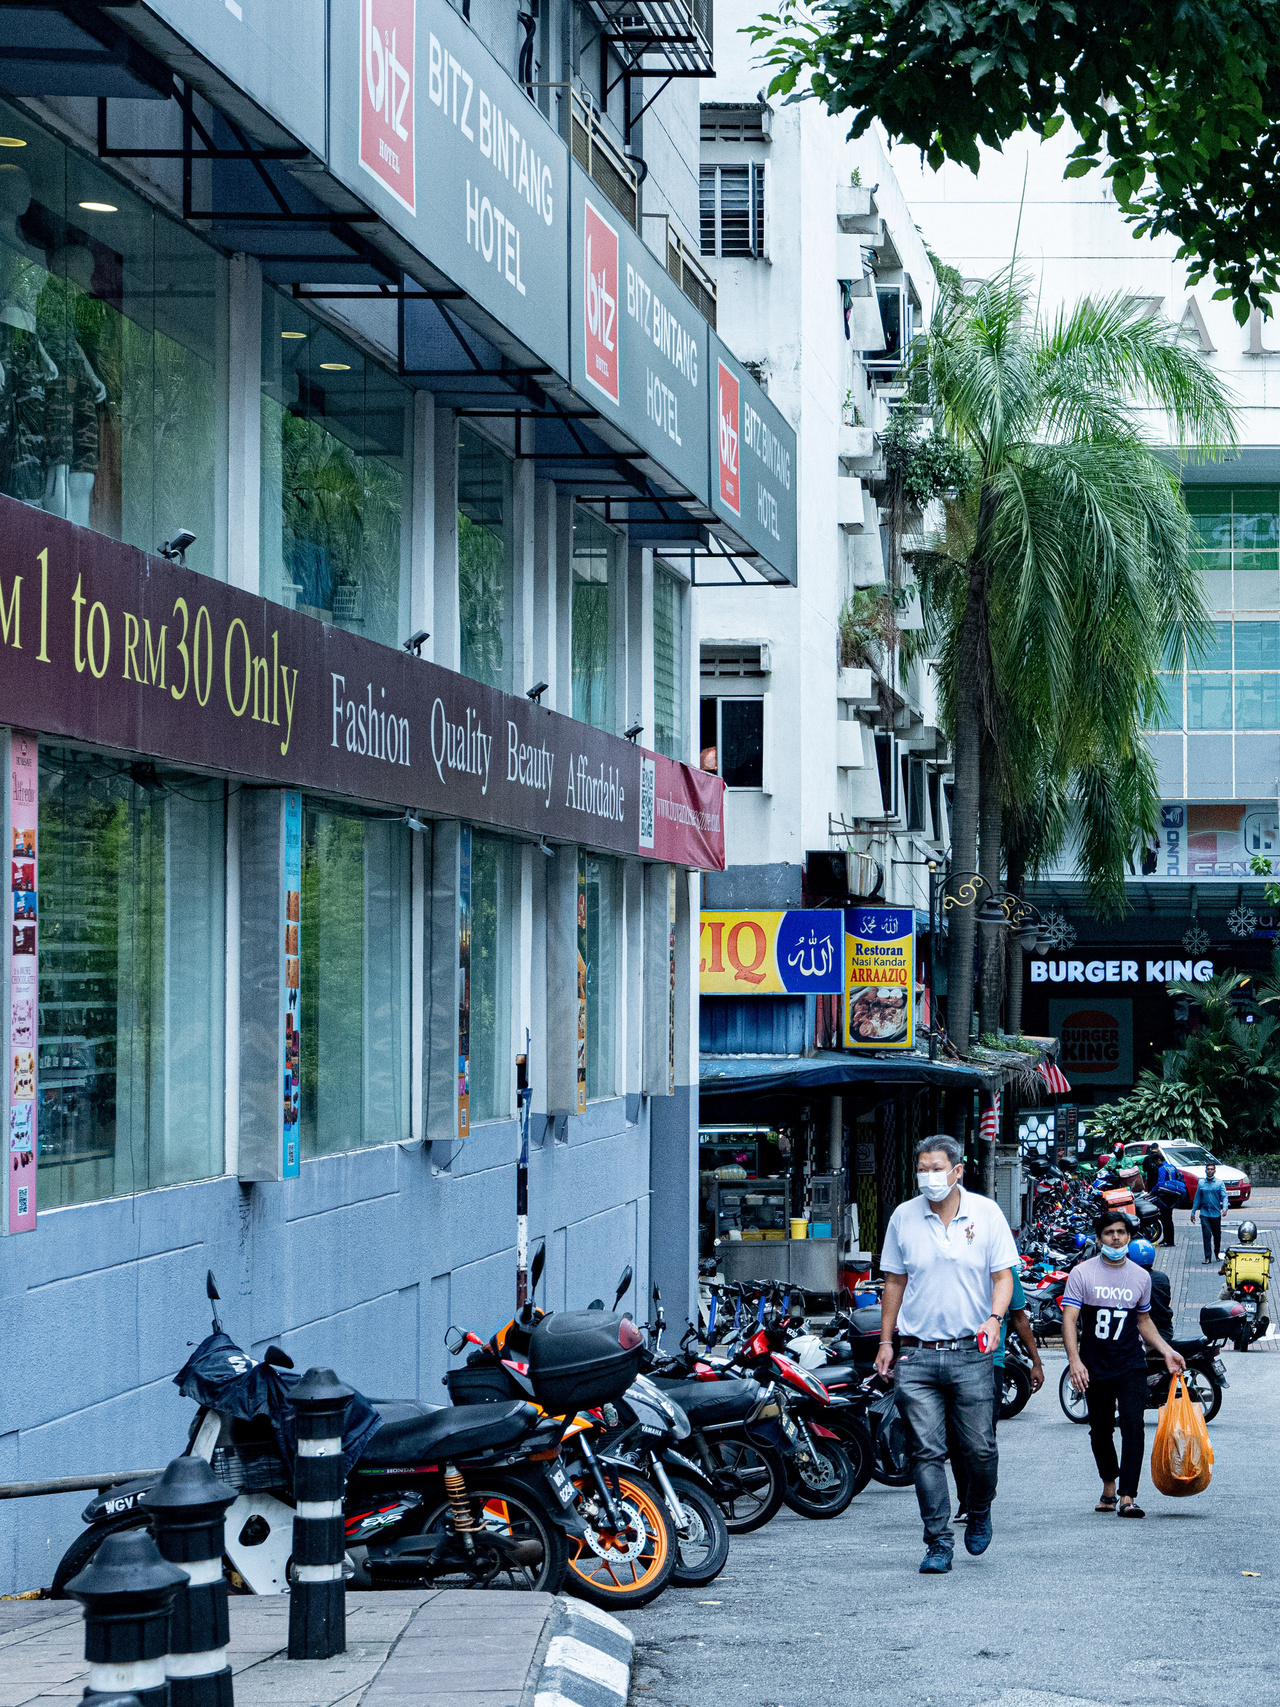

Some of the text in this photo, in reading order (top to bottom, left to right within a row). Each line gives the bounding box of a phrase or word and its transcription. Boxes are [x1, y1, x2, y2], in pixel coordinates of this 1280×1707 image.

[429, 31, 553, 227] BITZ BINTANG
[378, 138, 400, 175] HOTEL
[466, 179, 526, 297] HOTEL
[586, 234, 616, 352] bitz
[626, 262, 698, 388] BITZ BINTANG
[646, 367, 682, 447] HOTEL
[744, 401, 790, 491] BITZ BINTANG
[757, 481, 780, 542] HOTEL
[71, 572, 112, 679] to
[122, 597, 213, 707] RM30
[225, 617, 299, 757] Only
[330, 672, 625, 823] Fashion Quality Beauty Affordable
[700, 920, 767, 985] IQ
[852, 957, 907, 966] Nasi Kandar
[855, 942, 903, 956] Restoran
[1030, 960, 1214, 983] BURGER KING
[850, 968, 908, 986] ARRAAZIQ
[1061, 1028, 1119, 1043] BURGER
[1061, 1044, 1120, 1062] KING
[1094, 1285, 1133, 1302] TOKYO
[1094, 1308, 1129, 1341] 87
[641, 1425, 662, 1437] YAMAHA
